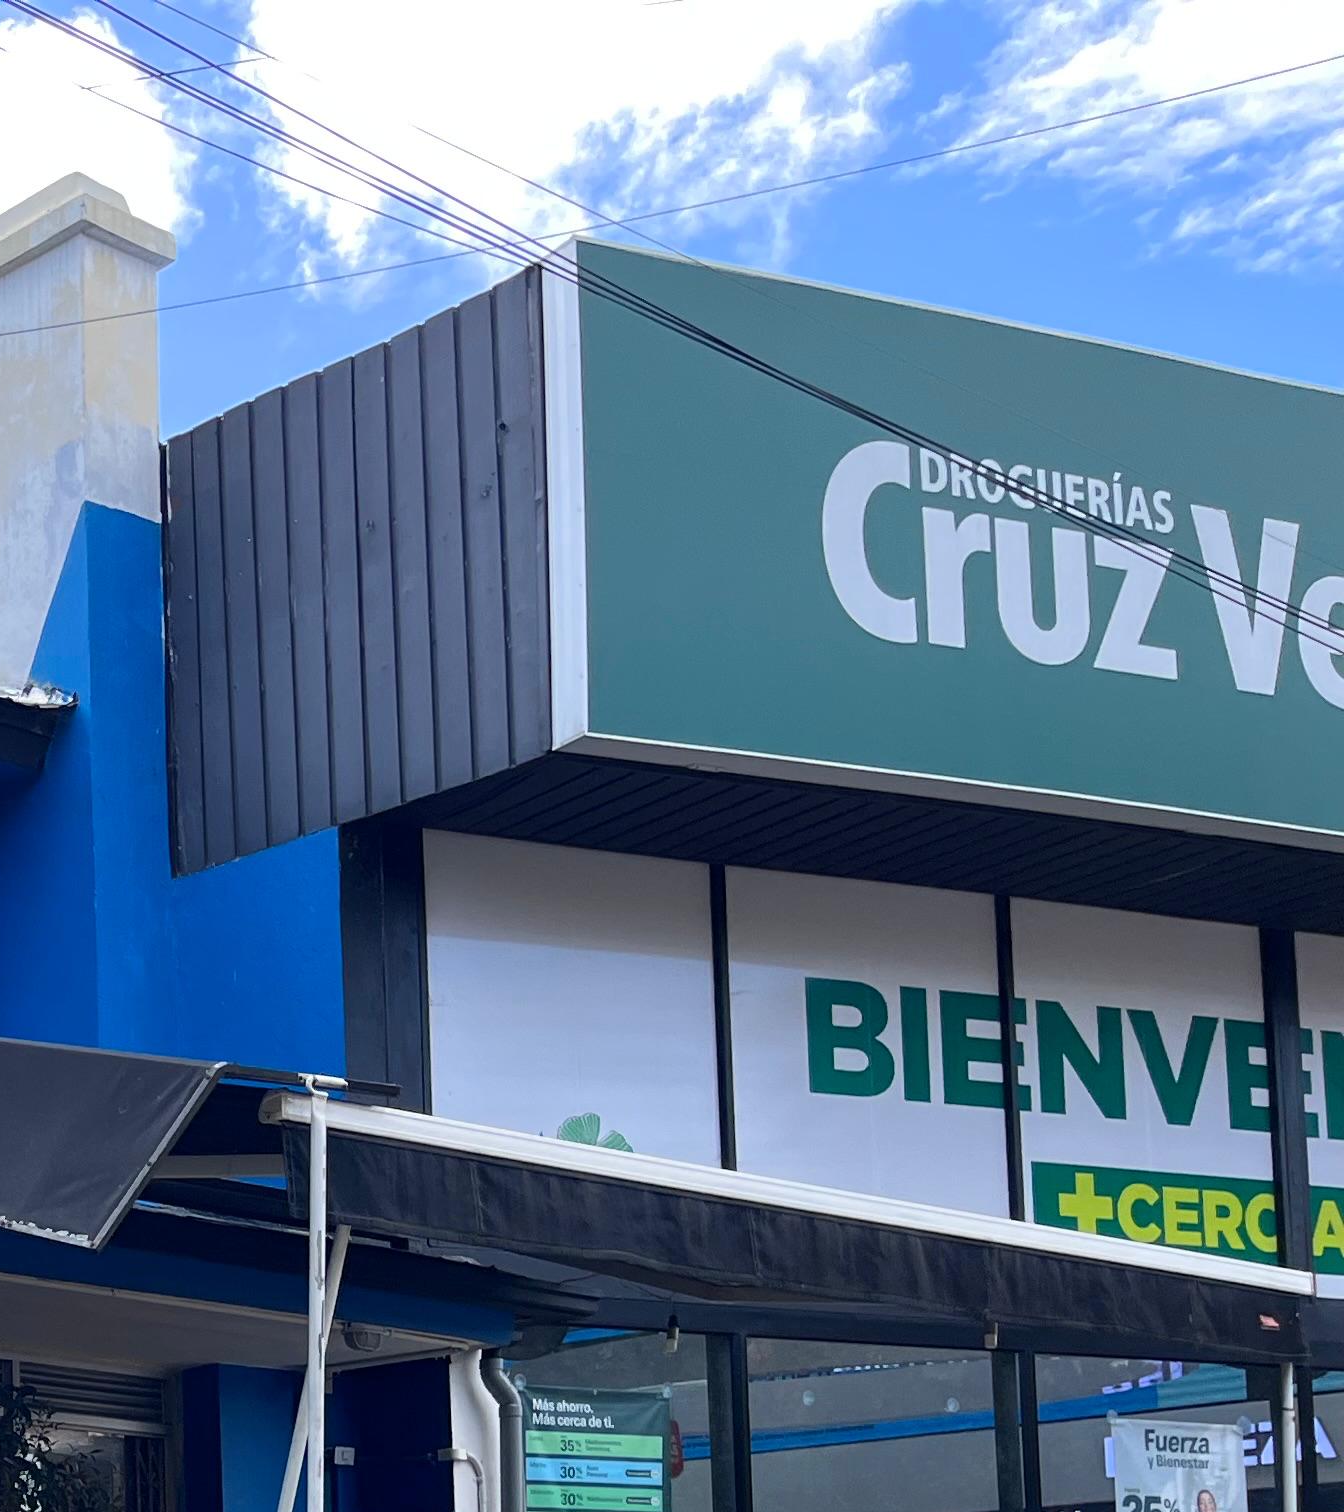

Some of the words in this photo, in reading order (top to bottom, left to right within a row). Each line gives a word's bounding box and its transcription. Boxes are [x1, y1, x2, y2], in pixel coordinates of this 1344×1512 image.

[919, 447, 1175, 534] DROGUERÍAS
[822, 440, 1179, 680] Cruz
[532, 1412, 556, 1425] Más
[557, 1416, 587, 1427] cerca
[588, 1415, 602, 1428] de
[1144, 1428, 1211, 1455] Fuerza
[1147, 1457, 1154, 1470] y
[1155, 1454, 1211, 1470] Bienestar
